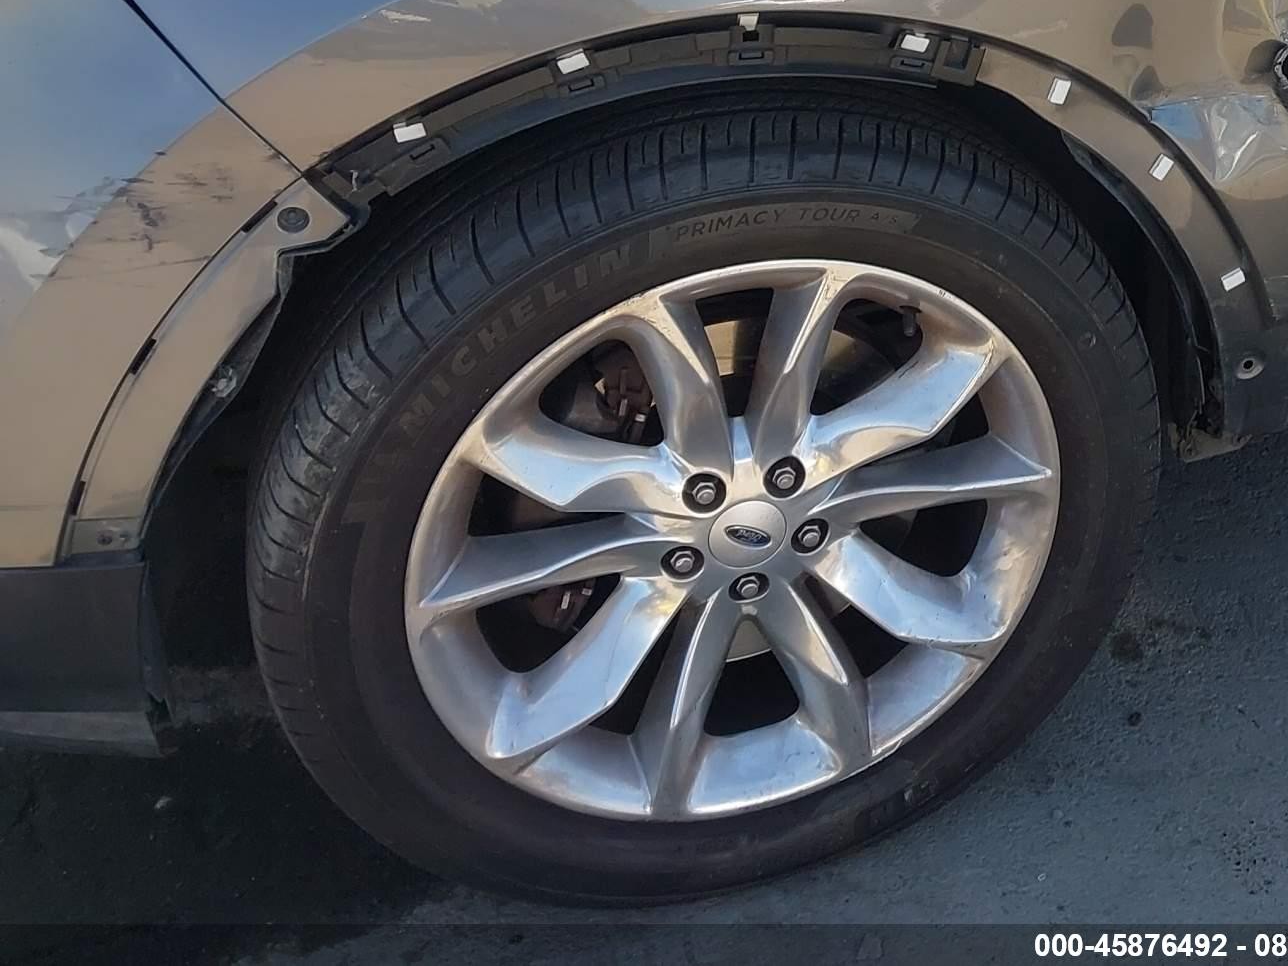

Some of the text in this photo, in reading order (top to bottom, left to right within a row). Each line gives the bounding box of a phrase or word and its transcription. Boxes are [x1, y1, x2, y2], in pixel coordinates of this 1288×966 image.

[676, 208, 786, 241] PRIMACY
[798, 207, 861, 223] TOUR
[398, 241, 635, 437] MICHELIN
